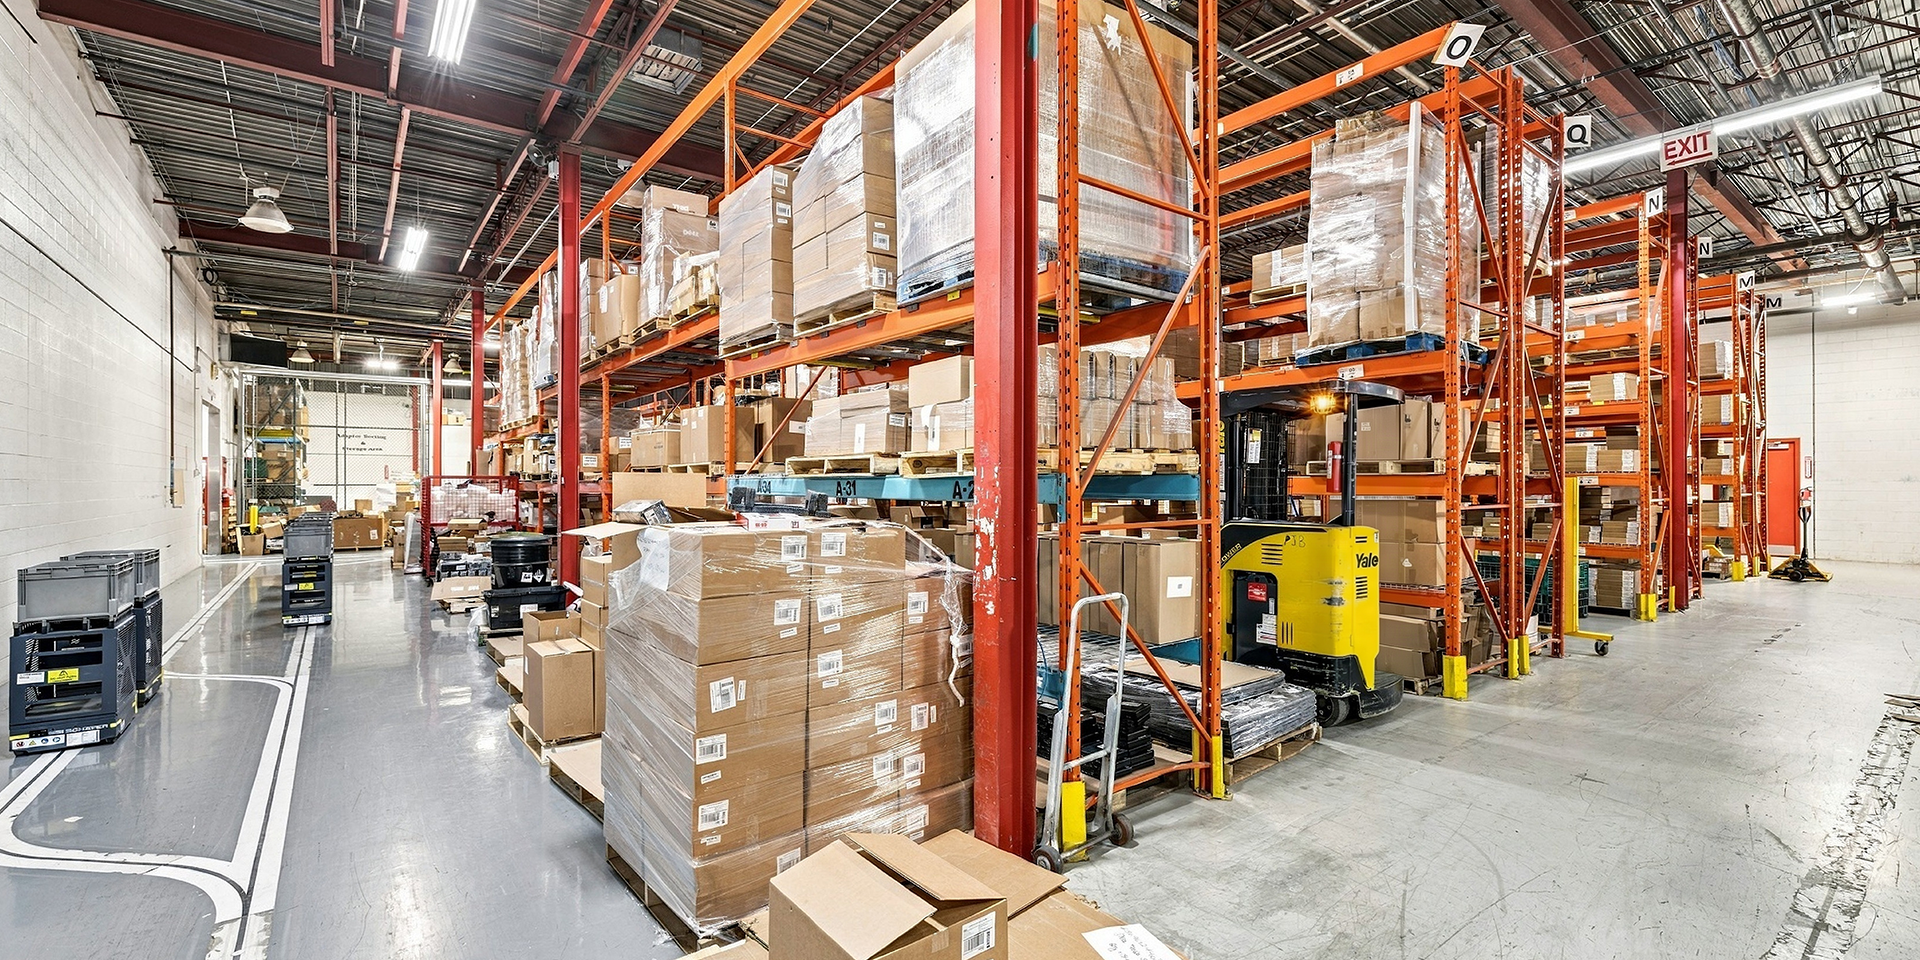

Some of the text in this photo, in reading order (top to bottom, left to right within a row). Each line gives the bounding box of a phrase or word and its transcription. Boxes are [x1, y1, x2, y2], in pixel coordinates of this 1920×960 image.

[1445, 35, 1473, 60] O
[1566, 123, 1588, 146] Q
[1663, 130, 1712, 163] EXIT
[1647, 194, 1661, 212] N
[1699, 242, 1710, 256] N
[1738, 275, 1754, 290] M
[1766, 296, 1783, 309] M
[835, 480, 857, 497] A-31
[952, 480, 975, 500] A-2
[1355, 552, 1380, 569] Yale
